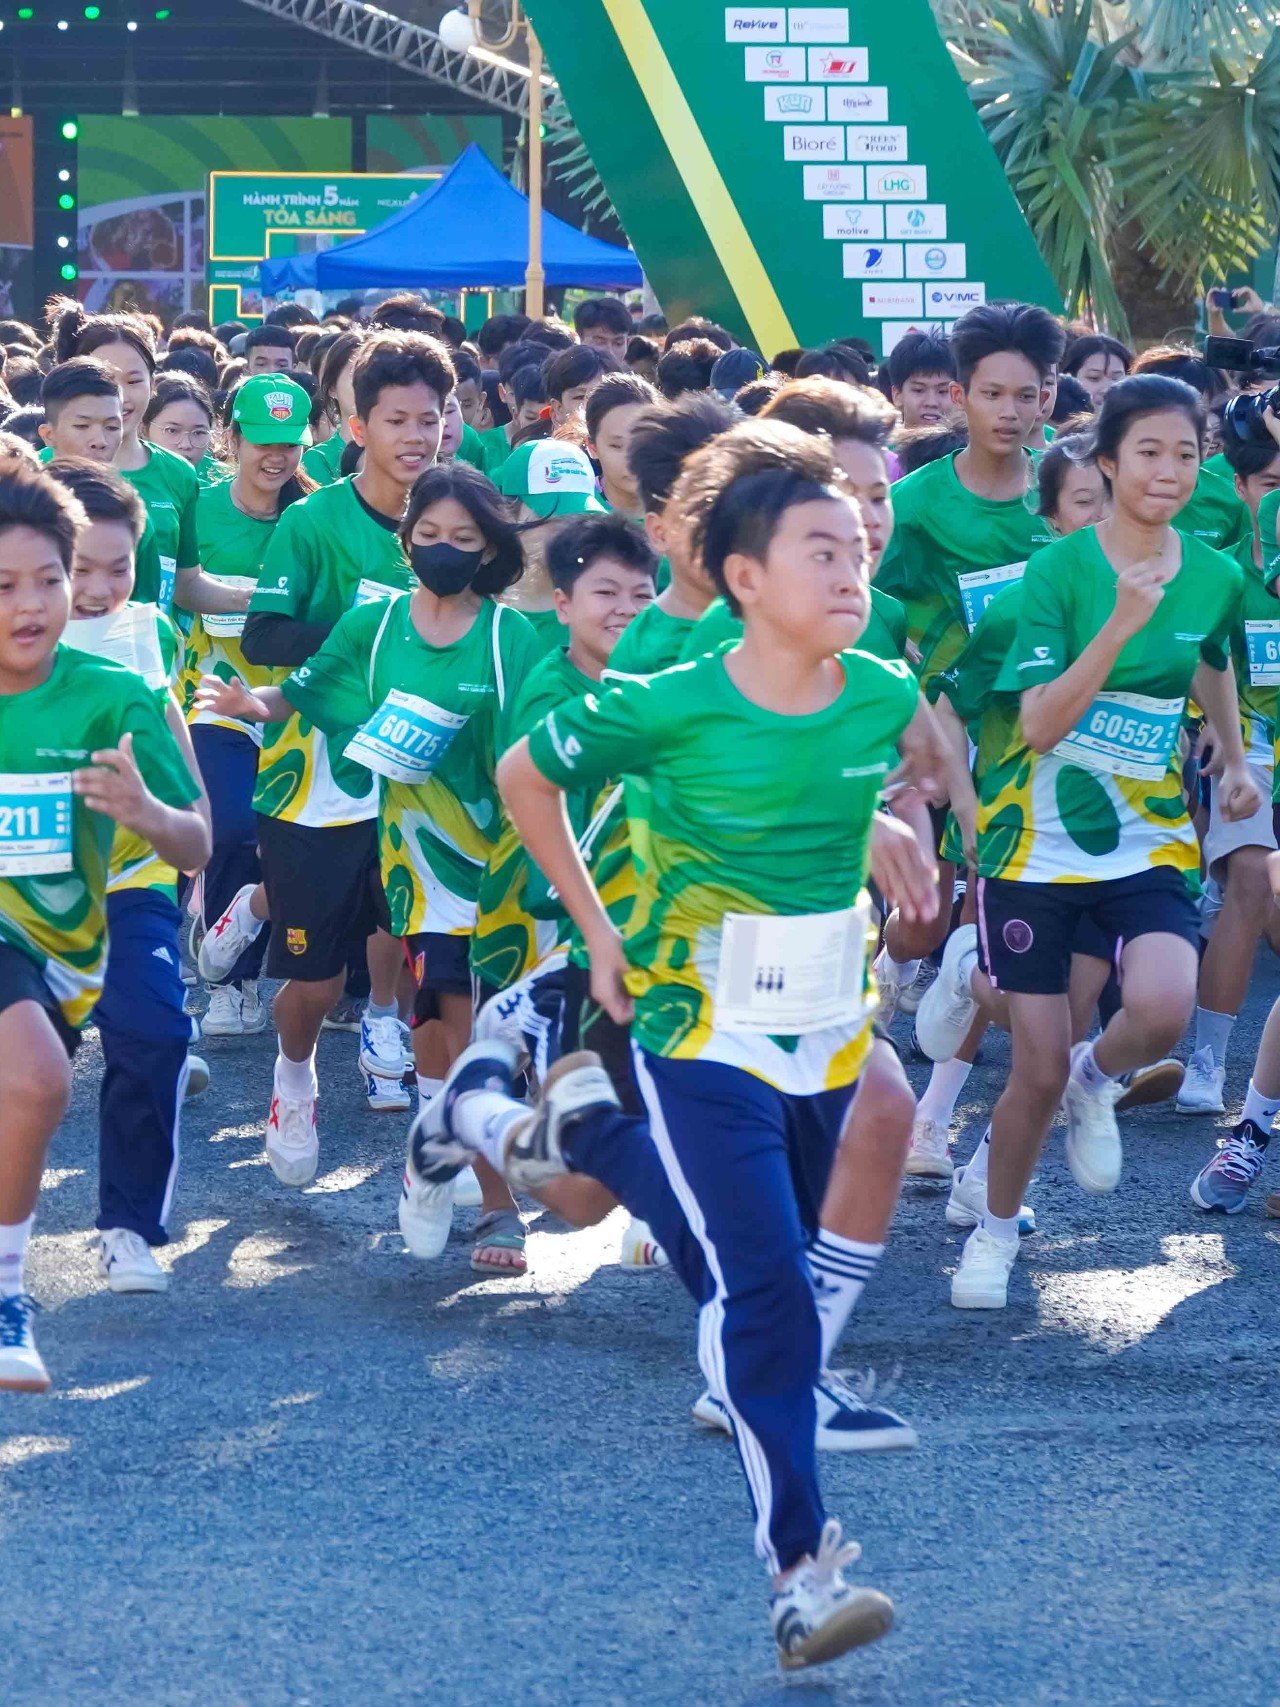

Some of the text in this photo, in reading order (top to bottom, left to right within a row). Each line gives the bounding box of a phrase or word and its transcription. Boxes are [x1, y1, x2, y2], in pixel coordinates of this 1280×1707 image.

[733, 19, 778, 30] ReVive
[792, 135, 837, 151] Bioré
[884, 179, 910, 191] LHG
[243, 191, 280, 206] HÀNH
[323, 185, 339, 207] 5
[305, 205, 357, 226] SÁNG
[837, 227, 869, 235] motive
[378, 714, 442, 757] 60775
[1090, 710, 1164, 749] 60552
